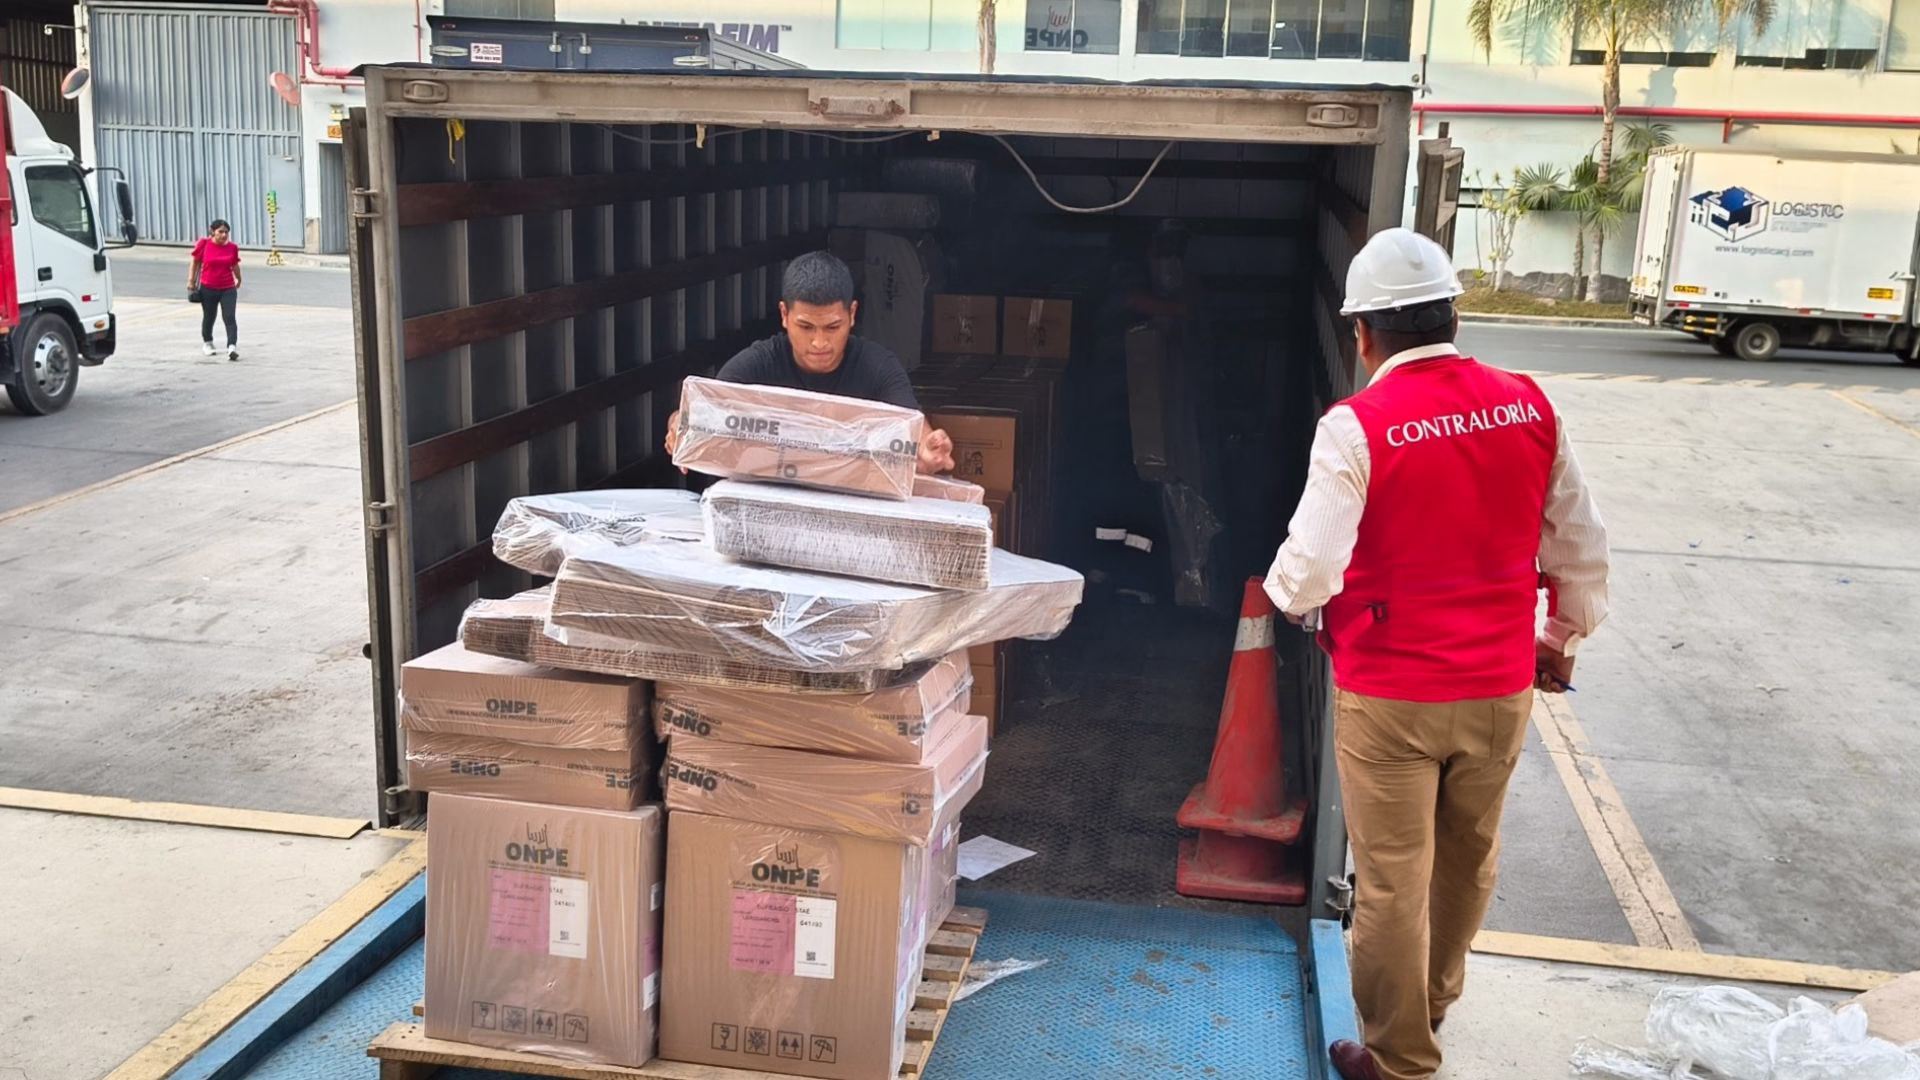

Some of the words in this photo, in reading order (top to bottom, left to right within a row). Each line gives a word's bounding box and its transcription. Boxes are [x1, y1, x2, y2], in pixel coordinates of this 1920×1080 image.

[724, 415, 780, 436] ONPE
[1386, 398, 1542, 447] CONTRALORÍA
[889, 438, 918, 456] ON
[486, 698, 538, 715] ONPE
[662, 708, 711, 736] ONPE
[897, 721, 927, 736] PE
[450, 761, 501, 777] ONPE
[668, 764, 717, 792] ONPE
[605, 774, 632, 789] PE
[505, 842, 569, 867] ONPE
[752, 862, 820, 888] ONPE
